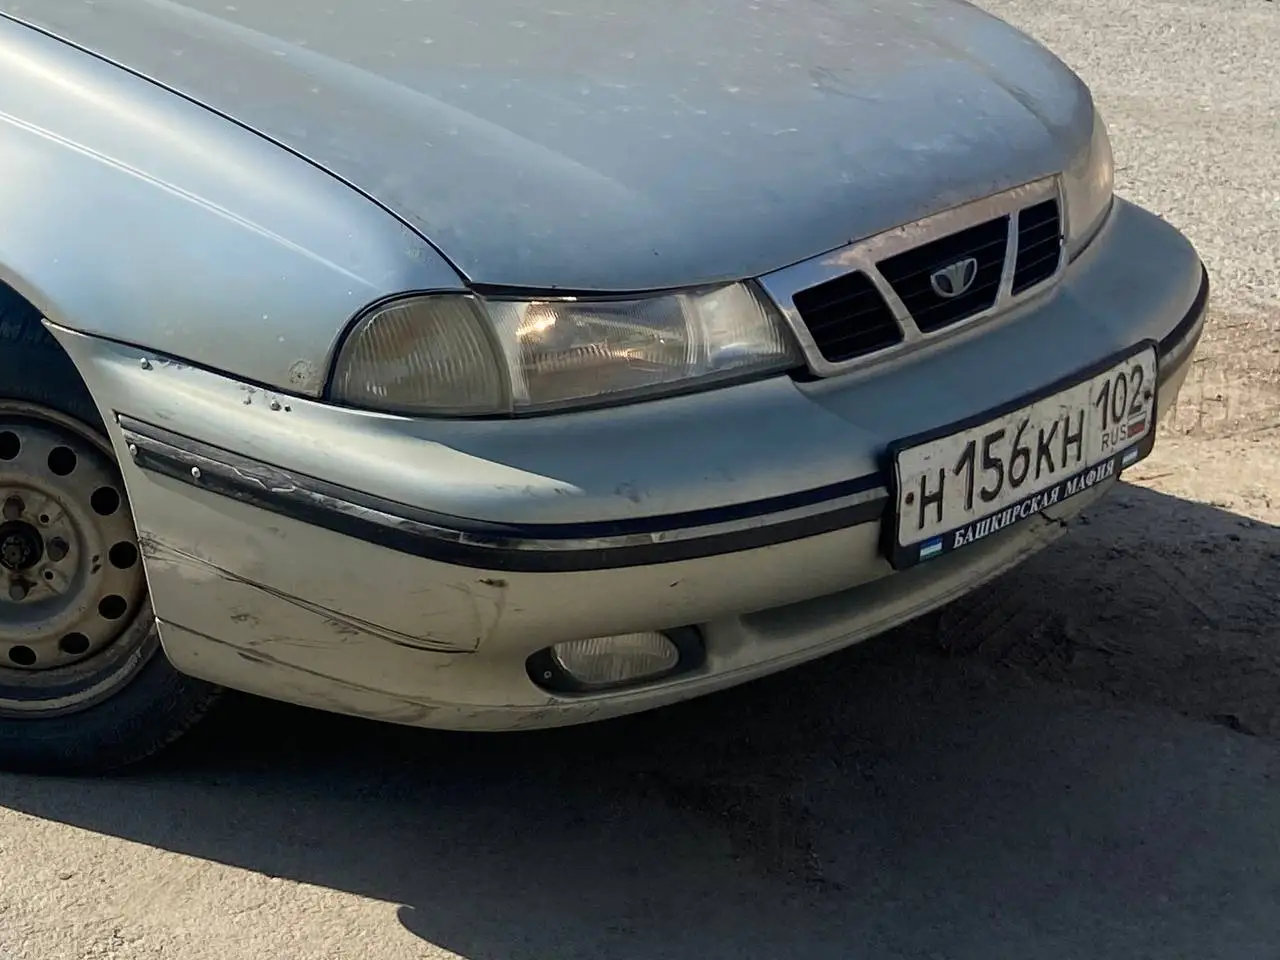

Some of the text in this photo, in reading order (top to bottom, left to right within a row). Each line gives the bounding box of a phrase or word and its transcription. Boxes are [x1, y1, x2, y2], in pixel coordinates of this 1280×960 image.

[1095, 364, 1144, 431] 102
[1101, 425, 1128, 452] RUS
[952, 459, 1115, 550] БАШКИРСКАЯ МАФИЯ
